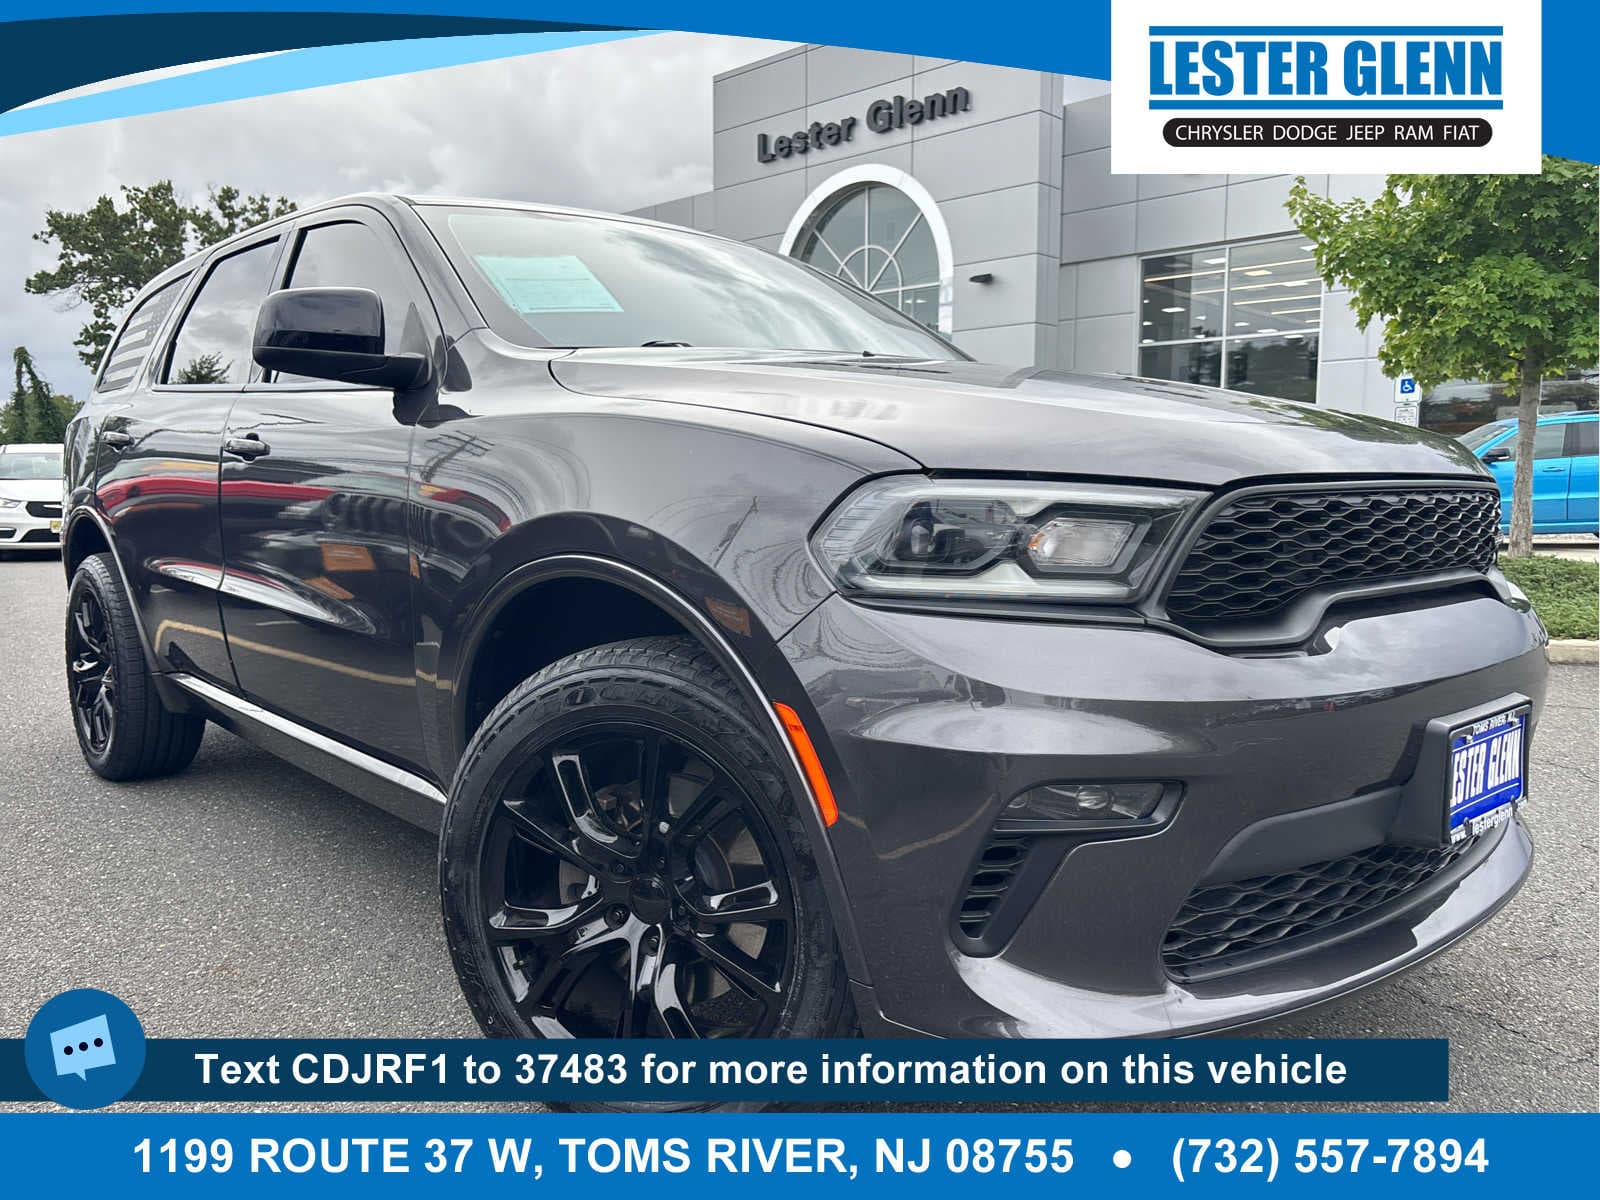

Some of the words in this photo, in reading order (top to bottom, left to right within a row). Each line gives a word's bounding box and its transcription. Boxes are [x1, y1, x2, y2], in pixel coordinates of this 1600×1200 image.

[757, 116, 857, 164] Lester
[866, 86, 972, 134] Glenn
[1488, 728, 1521, 790] GLENN
